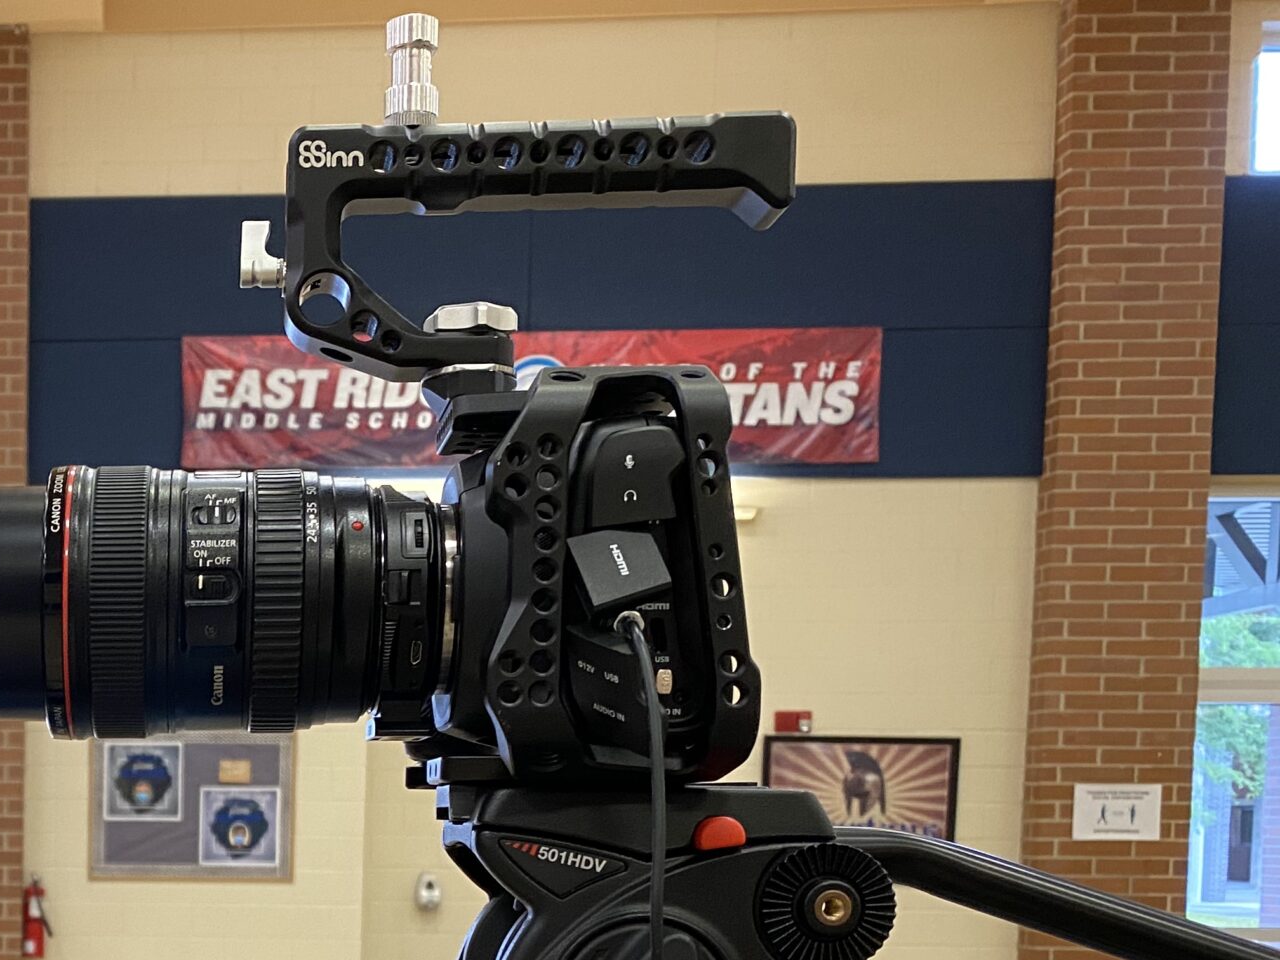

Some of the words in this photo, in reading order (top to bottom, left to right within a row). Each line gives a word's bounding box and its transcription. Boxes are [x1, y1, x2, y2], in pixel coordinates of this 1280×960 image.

[721, 362, 763, 380] OF
[792, 360, 863, 380] THE
[199, 368, 327, 409] EAST
[333, 368, 421, 409] RID
[196, 412, 323, 430] MIDDLE
[346, 412, 433, 430] SCHO
[53, 474, 65, 494] ZOOM
[306, 486, 317, 495] 50
[50, 497, 62, 533] CANON
[306, 502, 317, 514] 35
[190, 540, 236, 548] STABILIZER
[193, 549, 208, 558] ON
[214, 556, 232, 565] OFF
[609, 543, 630, 577] HDMI
[211, 665, 224, 706] Canon
[604, 671, 620, 684] USB
[536, 846, 608, 873] 501HDV
